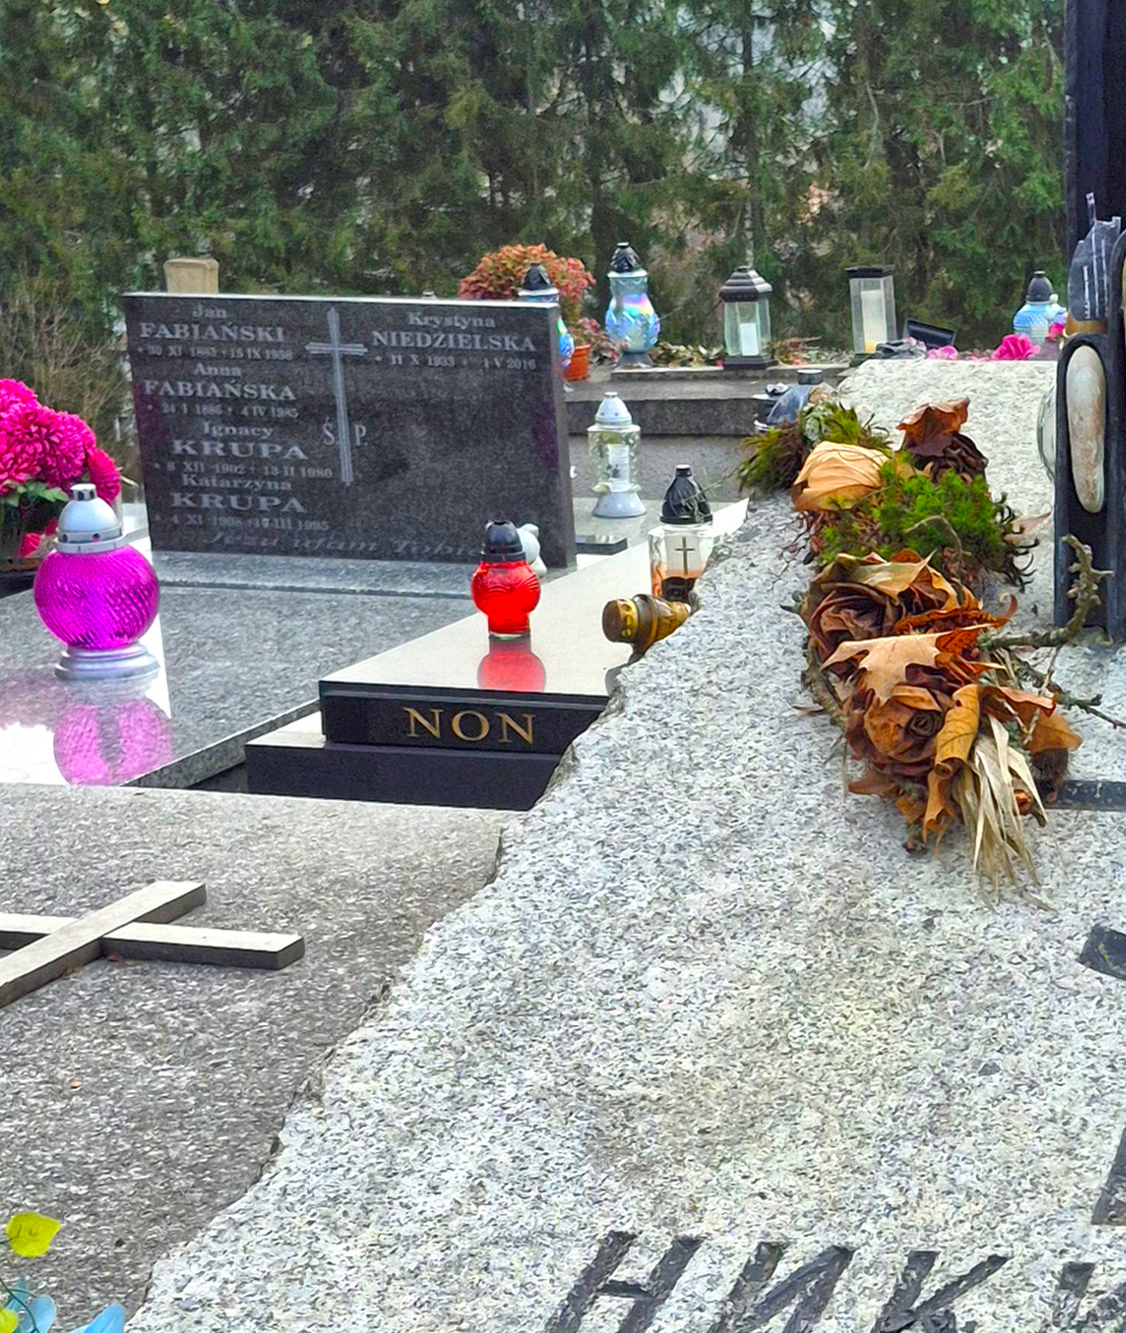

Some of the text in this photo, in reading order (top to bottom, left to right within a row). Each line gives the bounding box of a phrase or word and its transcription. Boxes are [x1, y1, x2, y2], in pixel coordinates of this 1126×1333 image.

[192, 305, 228, 319] Jan
[408, 312, 496, 329] Krystyna
[139, 321, 285, 343] FABIAŃSKI
[372, 331, 537, 352] NIEDZIELSKA
[193, 362, 243, 377] Anna
[143, 378, 297, 401] FABIAŃSKA
[201, 421, 275, 440] Ignacy
[171, 439, 309, 461] KRUPA
[181, 473, 293, 492] Katarzyna
[170, 492, 308, 514] KRUPA
[402, 707, 536, 746] NON
